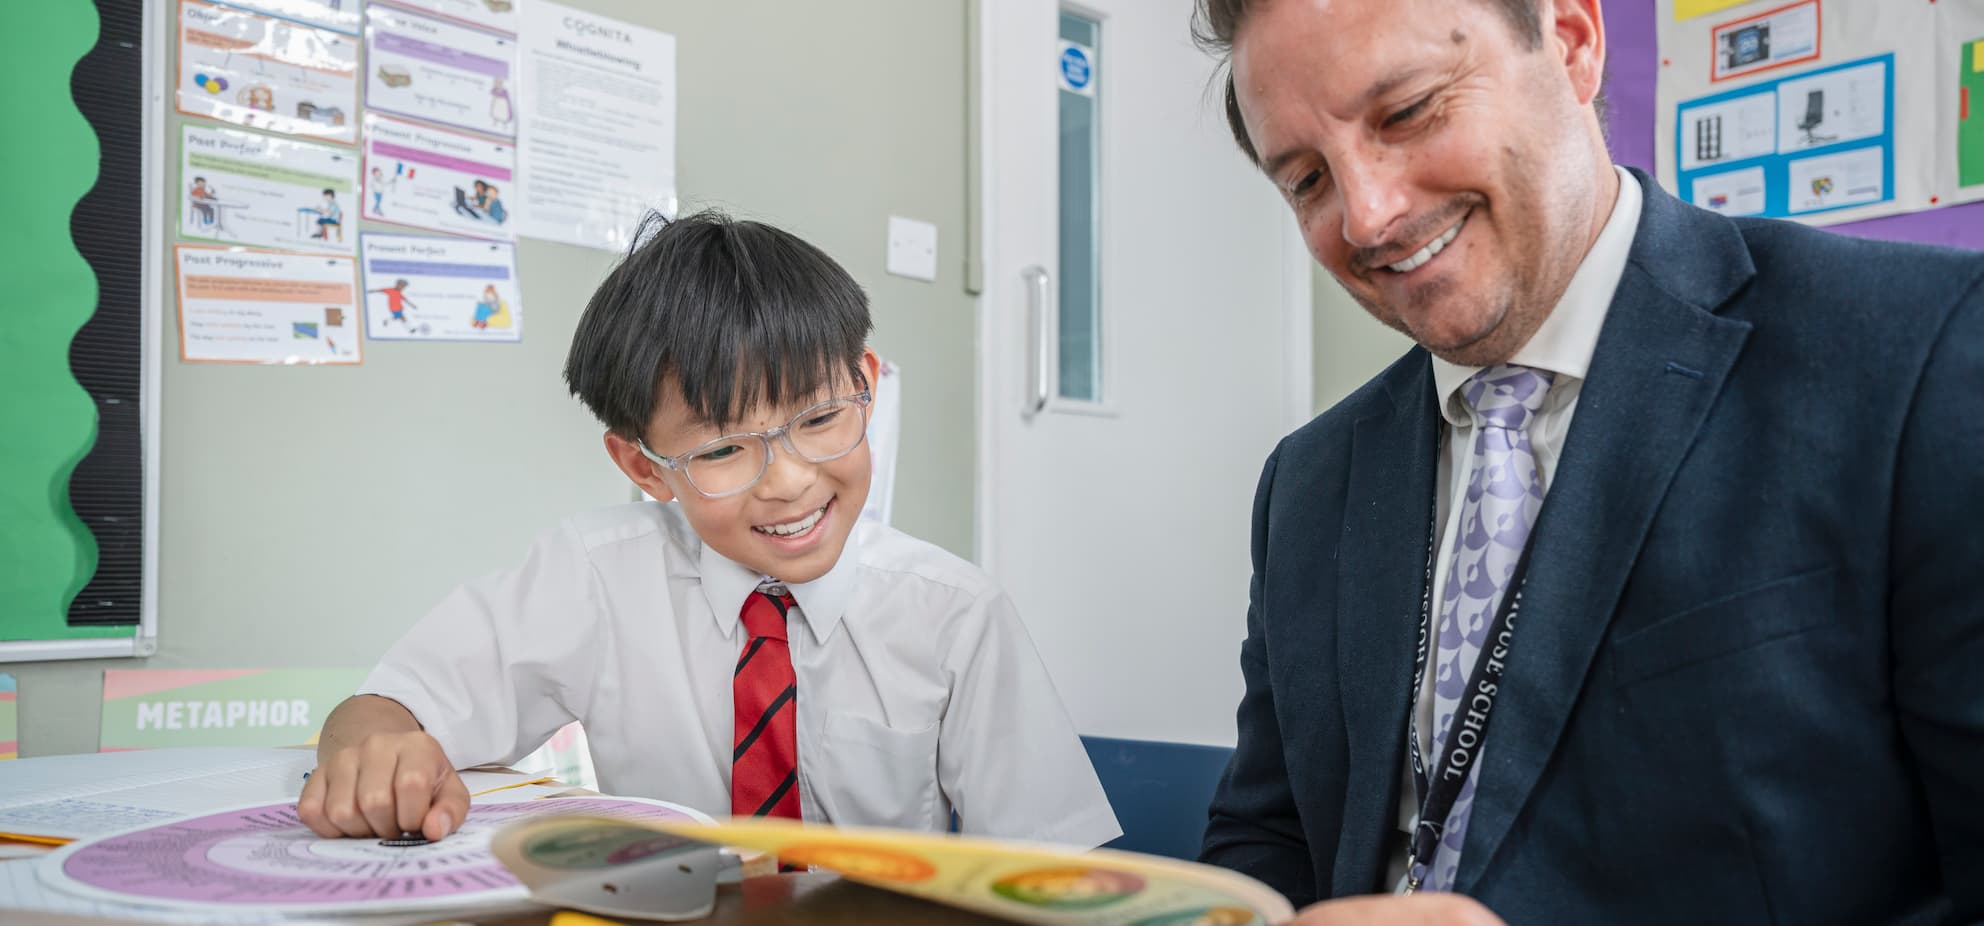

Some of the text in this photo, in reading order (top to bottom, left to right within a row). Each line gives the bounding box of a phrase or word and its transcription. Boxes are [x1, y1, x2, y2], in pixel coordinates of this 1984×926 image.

[562, 16, 632, 42] COGNITA
[556, 39, 641, 71] Whistleblowing
[188, 133, 215, 149] Past
[372, 125, 472, 153] Present Progressive
[184, 253, 283, 269] Past Progressive
[367, 243, 446, 257] Present Perfect
[136, 700, 310, 730] METAPHOR
[1443, 679, 1498, 781] SCHOOL
